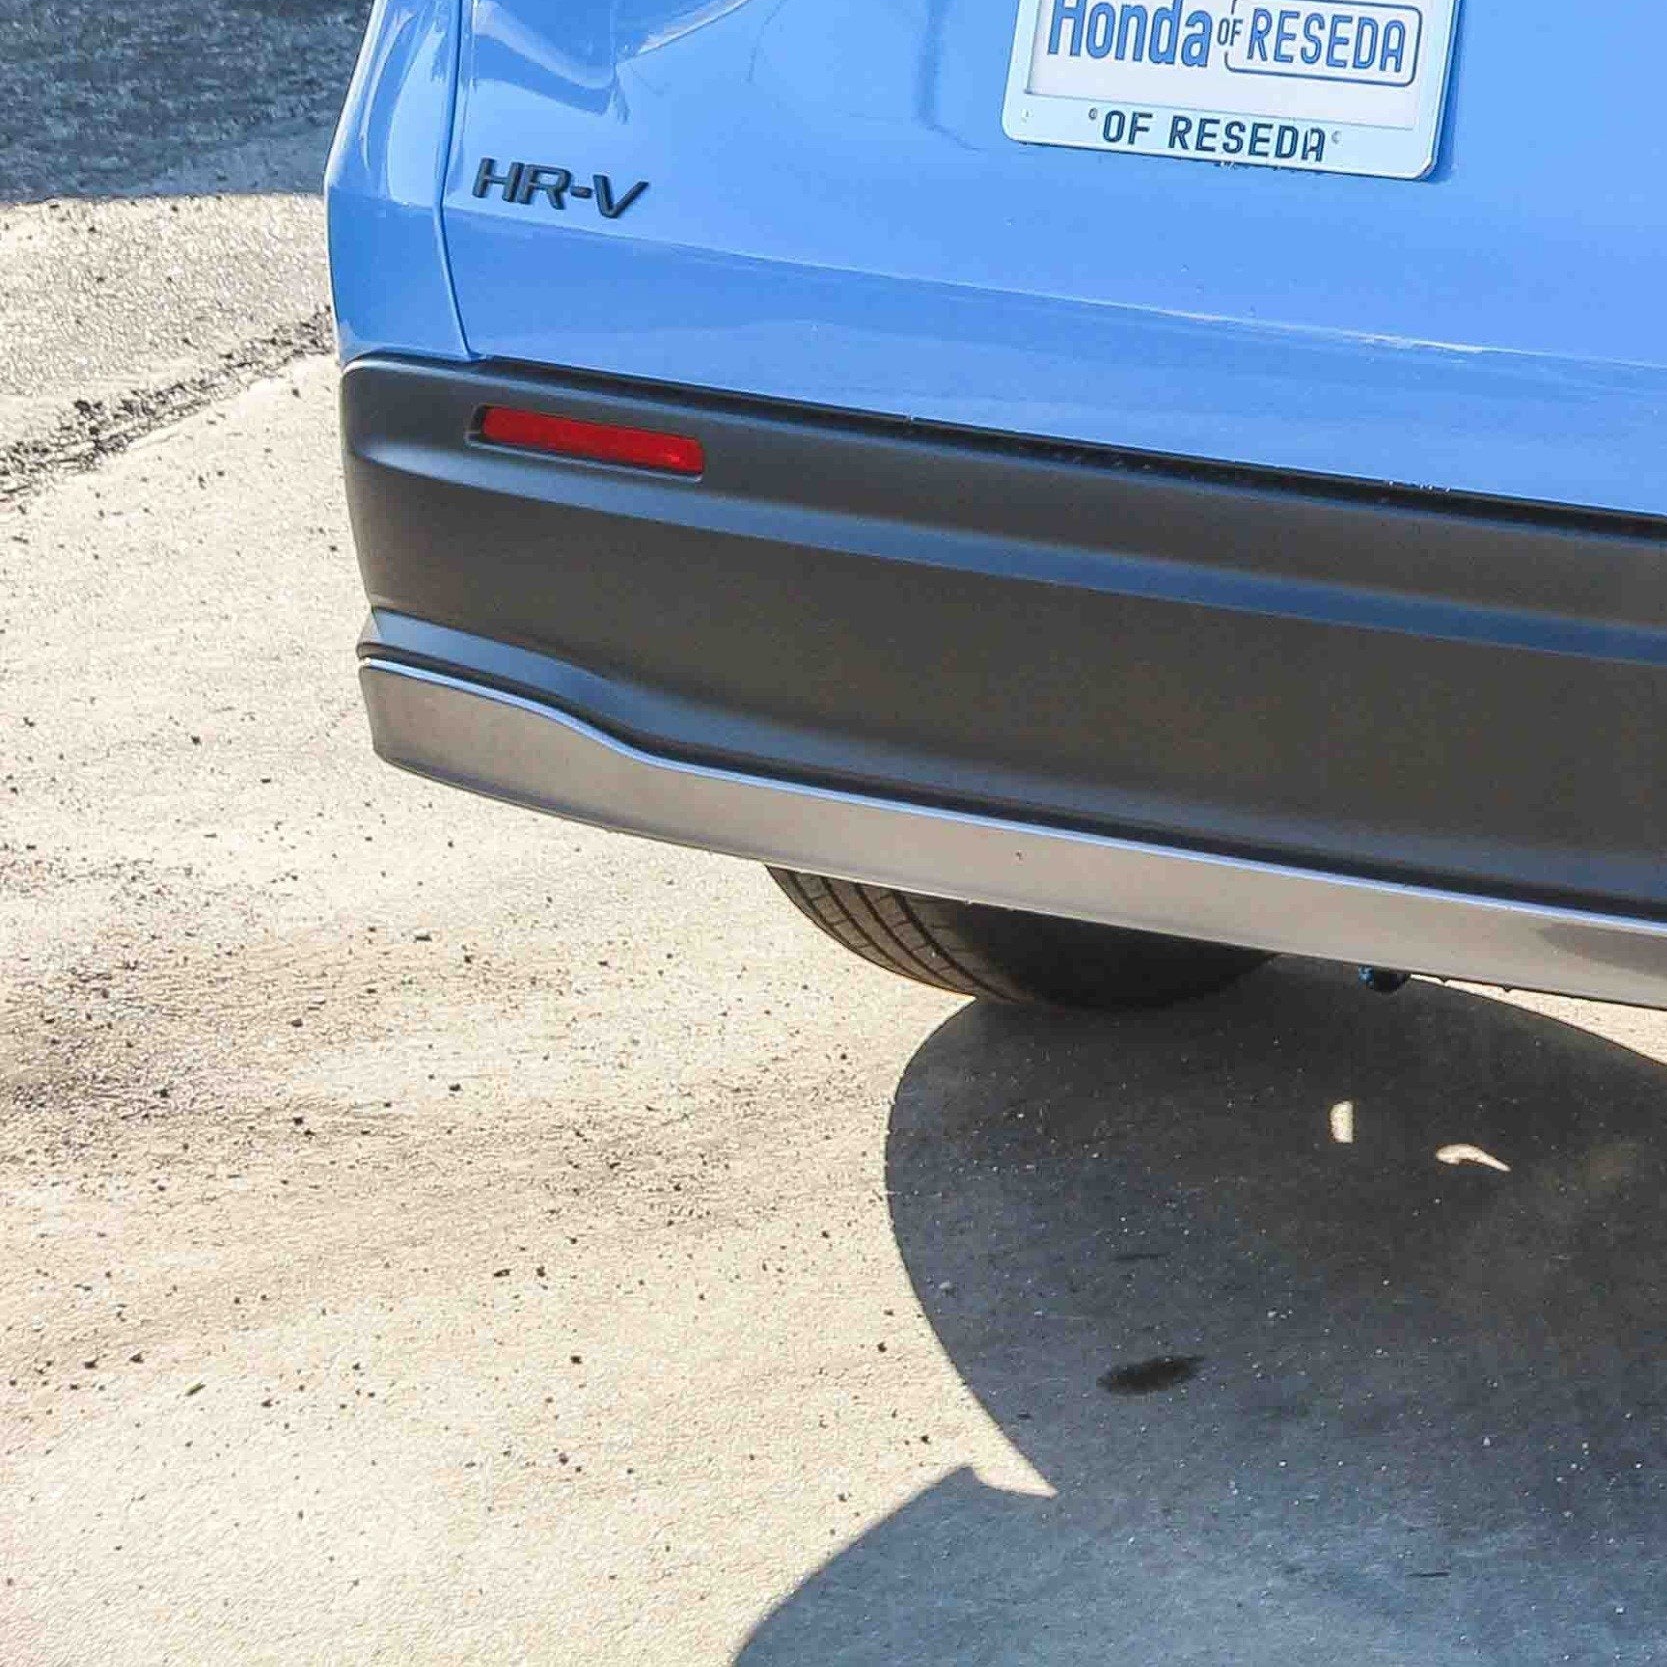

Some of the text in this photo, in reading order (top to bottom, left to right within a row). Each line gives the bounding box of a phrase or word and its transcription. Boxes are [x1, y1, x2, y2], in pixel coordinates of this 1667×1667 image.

[1217, 18, 1243, 45] OF
[1247, 7, 1406, 73] RESEDA
[1102, 110, 1326, 163] OF RESEDA
[472, 157, 650, 219] HR-V
